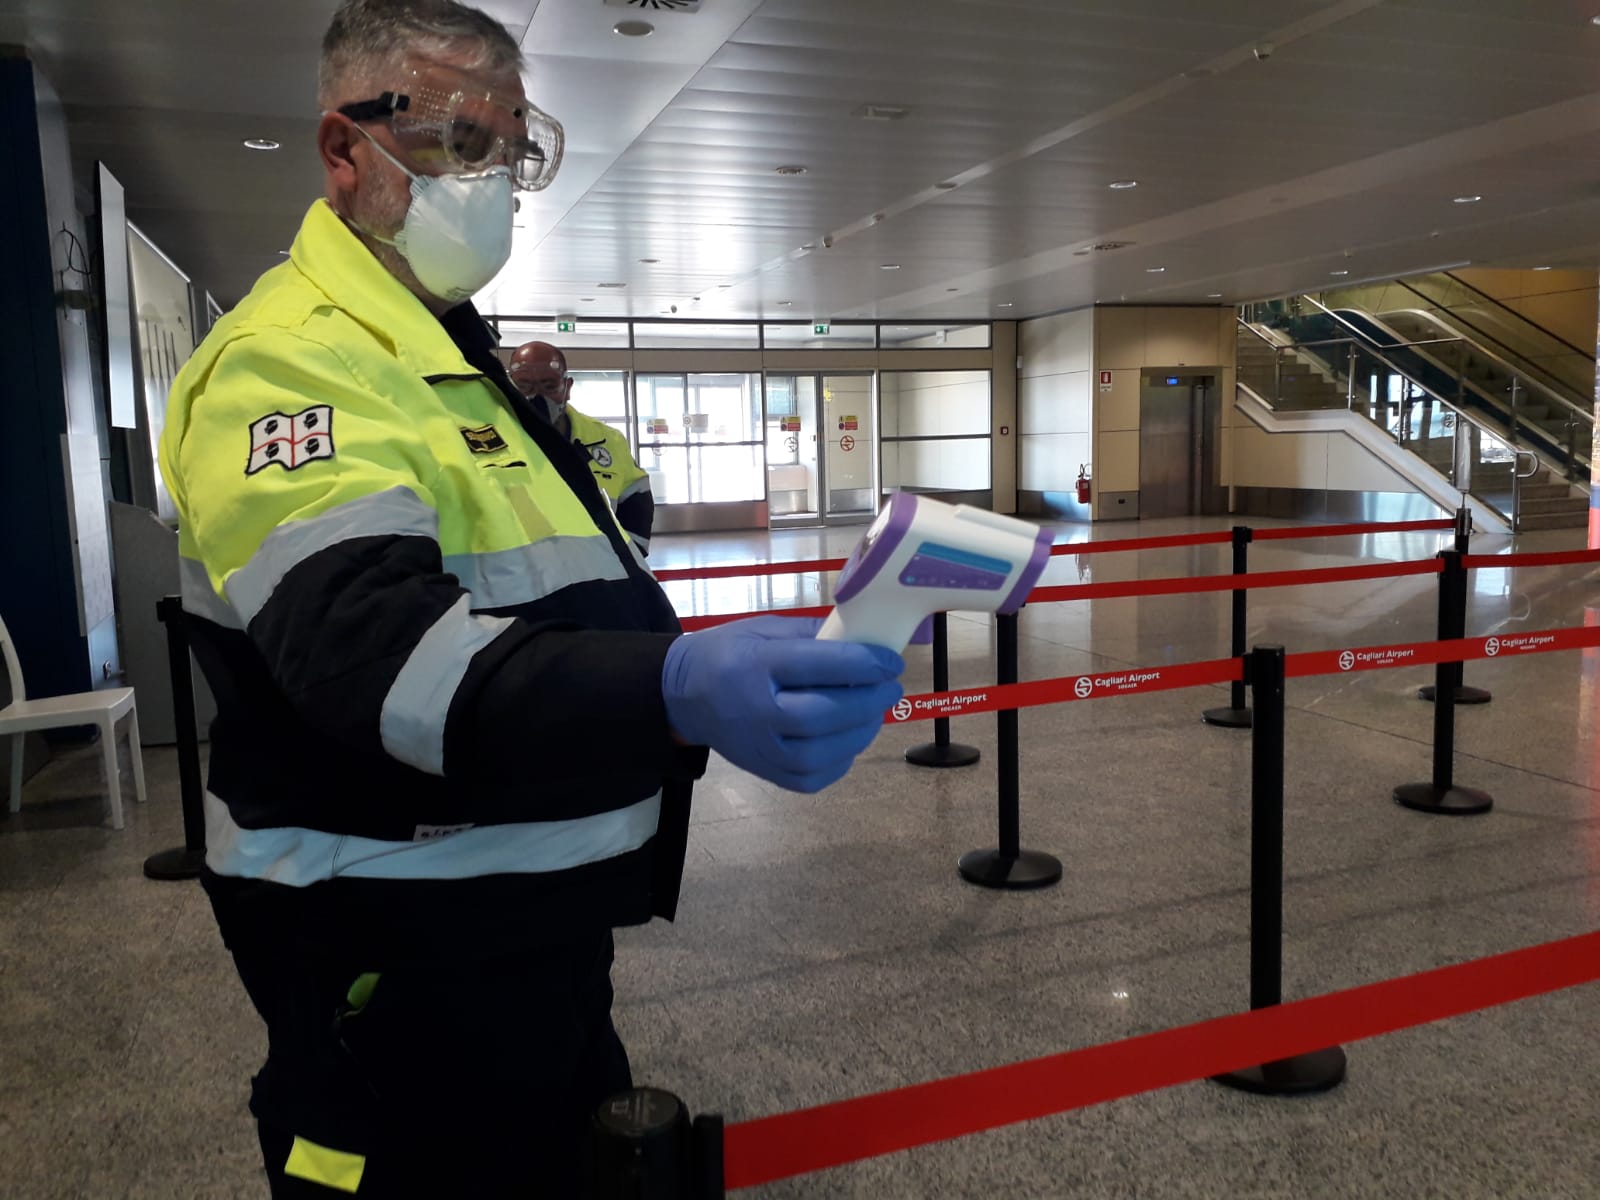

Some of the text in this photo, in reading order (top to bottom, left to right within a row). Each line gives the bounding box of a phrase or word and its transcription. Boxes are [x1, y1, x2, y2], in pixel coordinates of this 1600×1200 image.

[1501, 637, 1528, 648] Cagliari
[1529, 635, 1554, 645] Airport
[1356, 649, 1414, 662] Cagliari Airport
[1095, 672, 1160, 687] Cagliari Airport
[914, 694, 987, 710] Cagliari Airport
